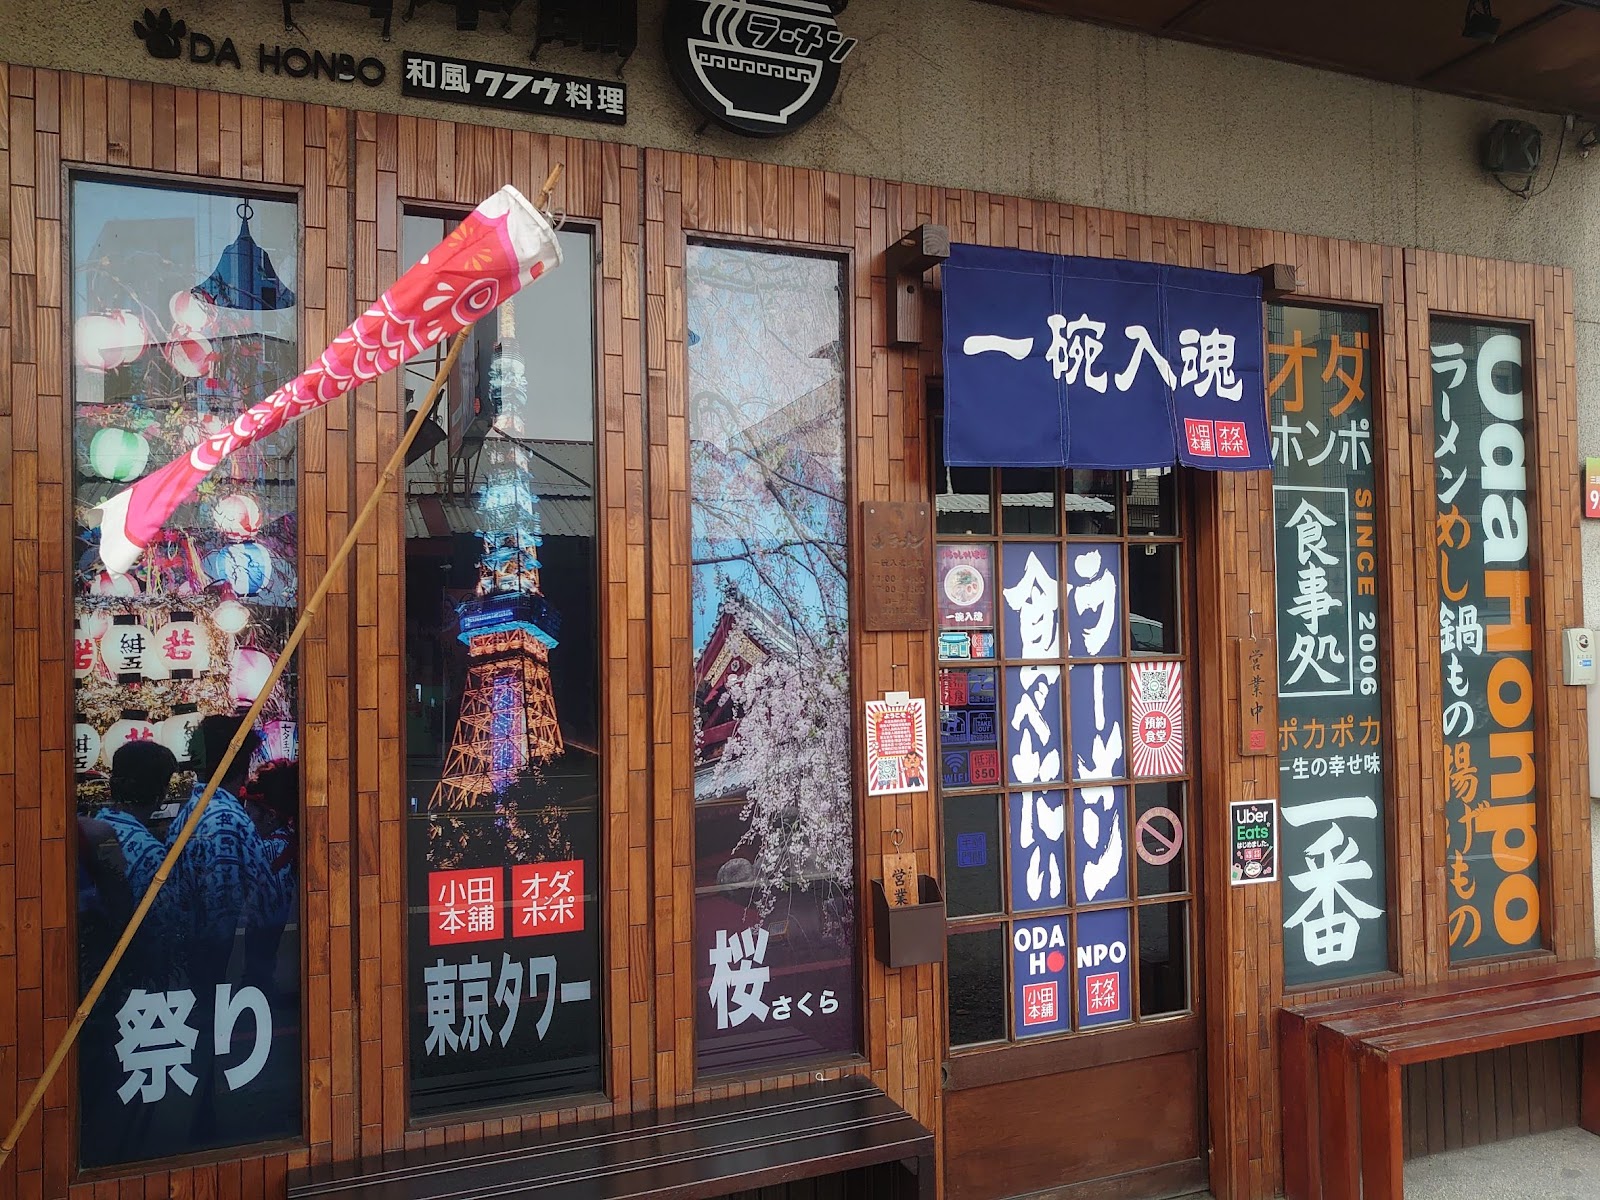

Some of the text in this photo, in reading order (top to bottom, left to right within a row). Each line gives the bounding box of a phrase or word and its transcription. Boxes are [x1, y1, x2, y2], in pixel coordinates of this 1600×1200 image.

[963, 313, 1243, 401] 一碗入魂
[1268, 330, 1370, 417] オダ
[1189, 423, 1210, 438] 小田
[1271, 415, 1372, 470] ホンポ
[1284, 497, 1345, 687] 食事処
[1355, 488, 1377, 696] SINCE 2006
[1145, 716, 1166, 730] 預約
[1145, 730, 1167, 744] 食堂
[1279, 714, 1380, 751] ポカポカ
[975, 768, 995, 779] $50
[1280, 752, 1381, 779] 一生の幸せ味
[1236, 809, 1268, 824] Uber
[1237, 825, 1269, 841] Eats
[439, 877, 494, 907] 小田
[522, 870, 575, 900] オダ
[1280, 796, 1387, 966] 一番
[1014, 924, 1065, 952] ODA
[708, 927, 839, 1030] 桜 さくら
[424, 952, 591, 1056] 東京タワー
[1028, 987, 1054, 1004] 小田
[114, 983, 273, 1105] 祭り
